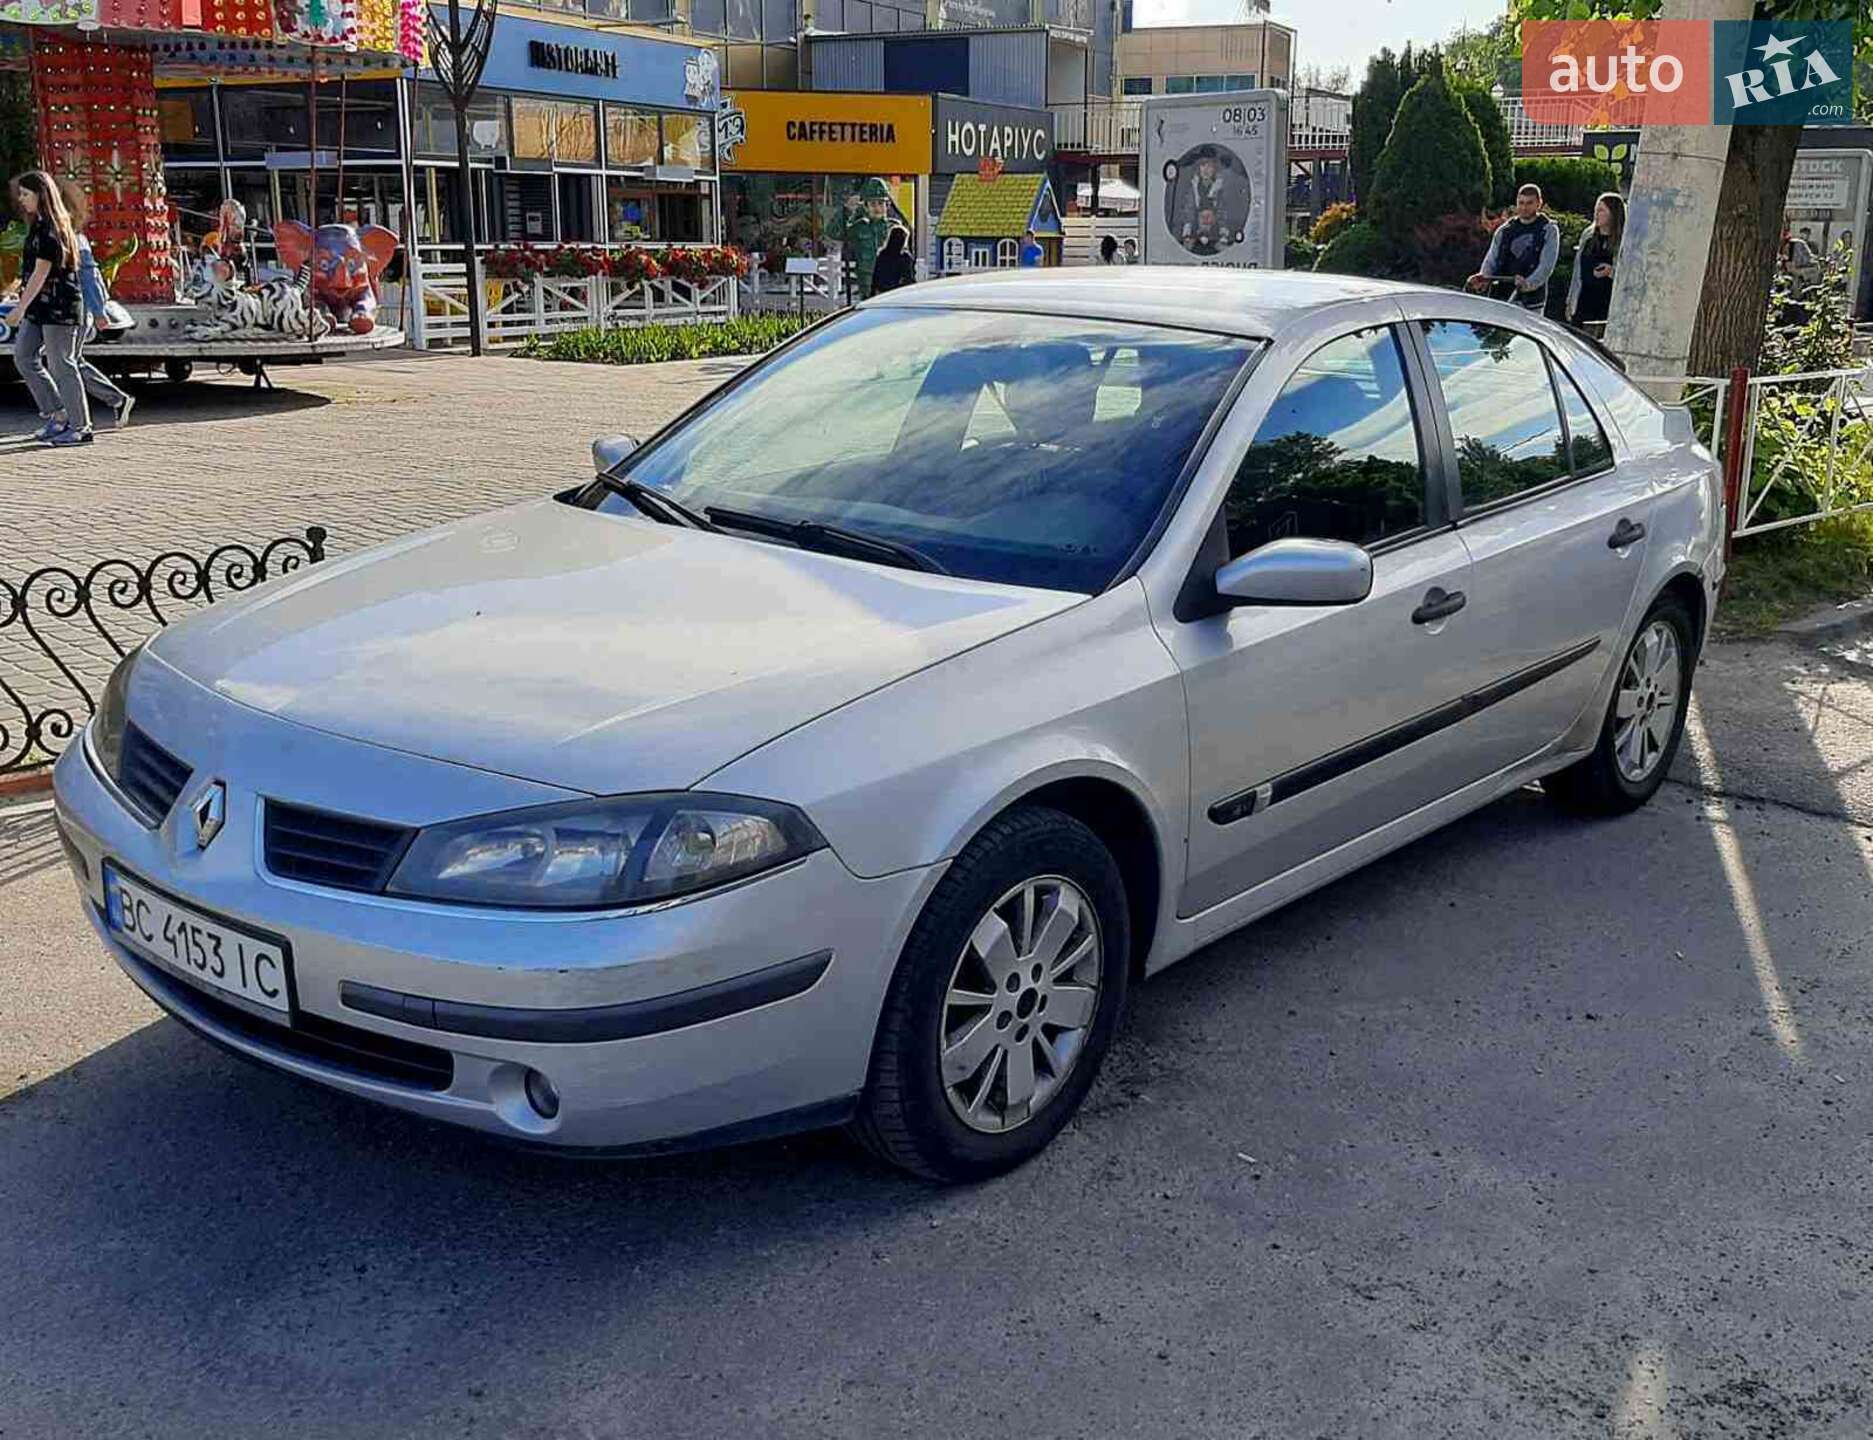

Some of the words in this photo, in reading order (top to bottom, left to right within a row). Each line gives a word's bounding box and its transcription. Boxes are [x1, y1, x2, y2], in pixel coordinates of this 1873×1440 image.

[528, 40, 619, 80] RISTORANTE
[786, 120, 896, 144] CAFFETTERIA
[947, 120, 1046, 160] НОТАРІУС
[120, 887, 154, 942] BC
[163, 914, 225, 979] 4153
[238, 943, 280, 998] IC
